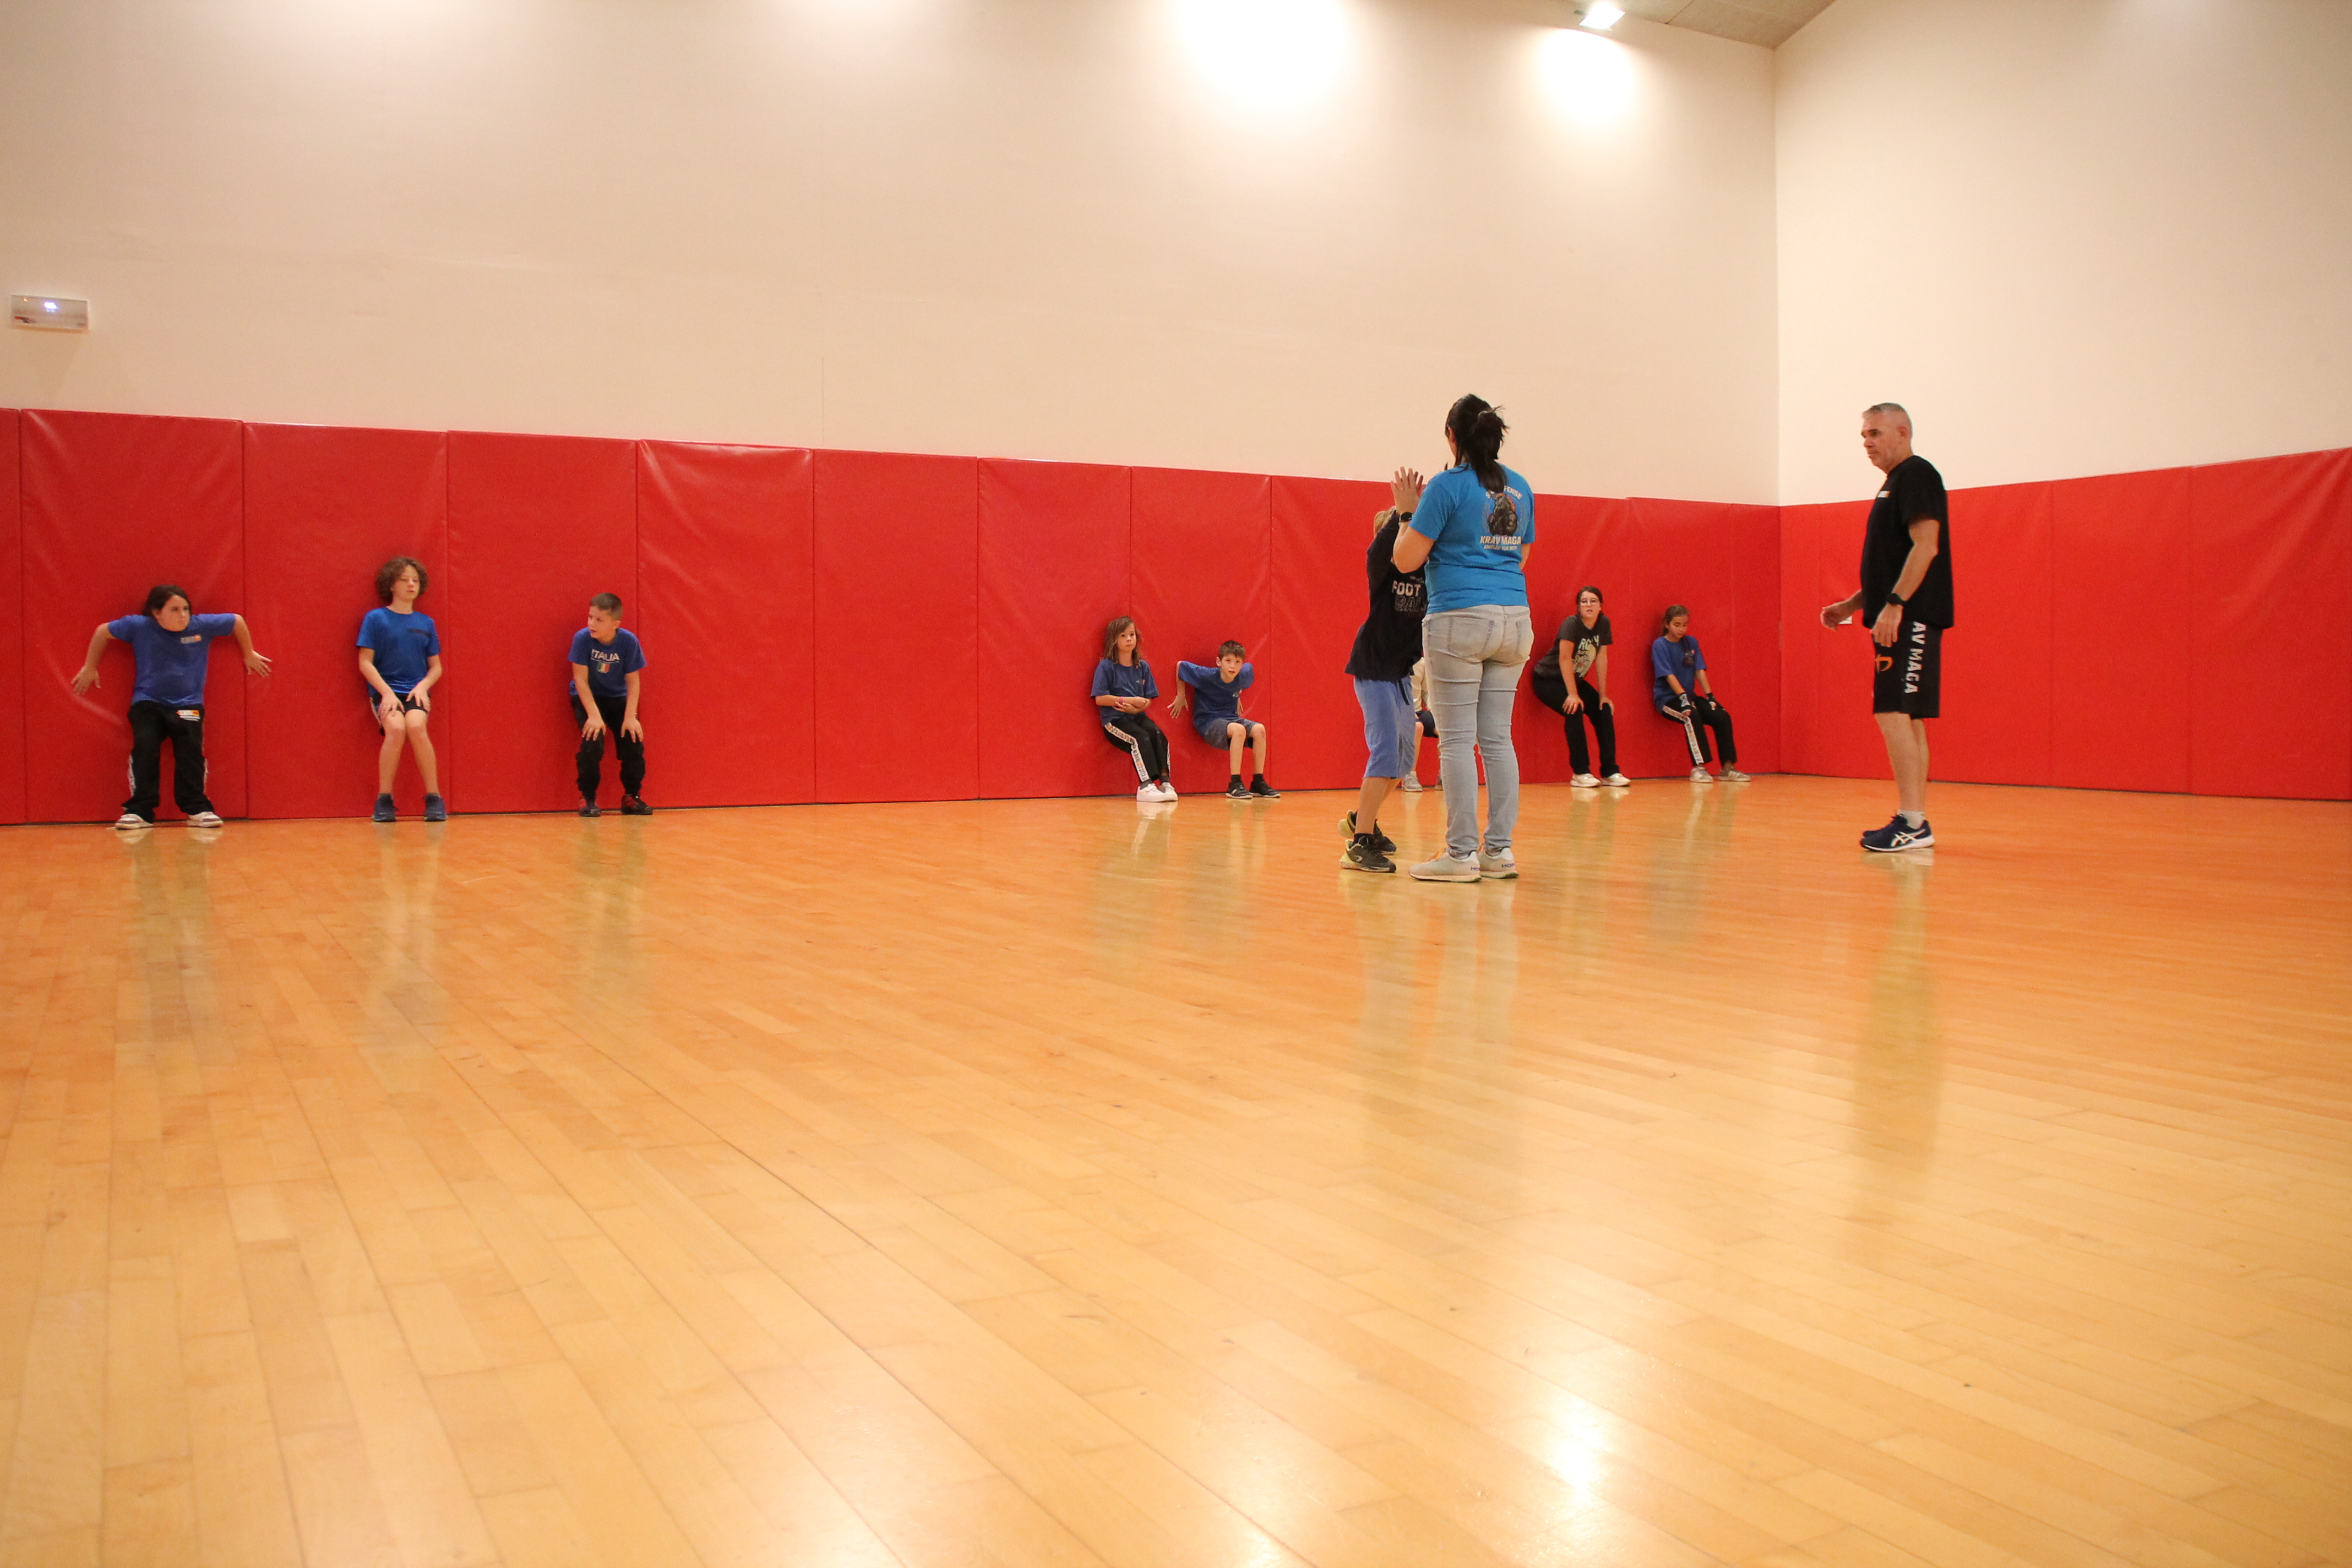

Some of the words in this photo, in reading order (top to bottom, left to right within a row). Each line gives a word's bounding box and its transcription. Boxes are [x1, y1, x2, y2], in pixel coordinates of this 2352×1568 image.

[1503, 485, 1523, 500] FENSE
[1480, 536, 1500, 545] KRAV
[1501, 536, 1521, 545] MAGA
[1392, 580, 1422, 597] FOOT
[1912, 621, 1927, 645] AV
[591, 649, 620, 661] ITALIA
[1904, 648, 1924, 693] MAGA
